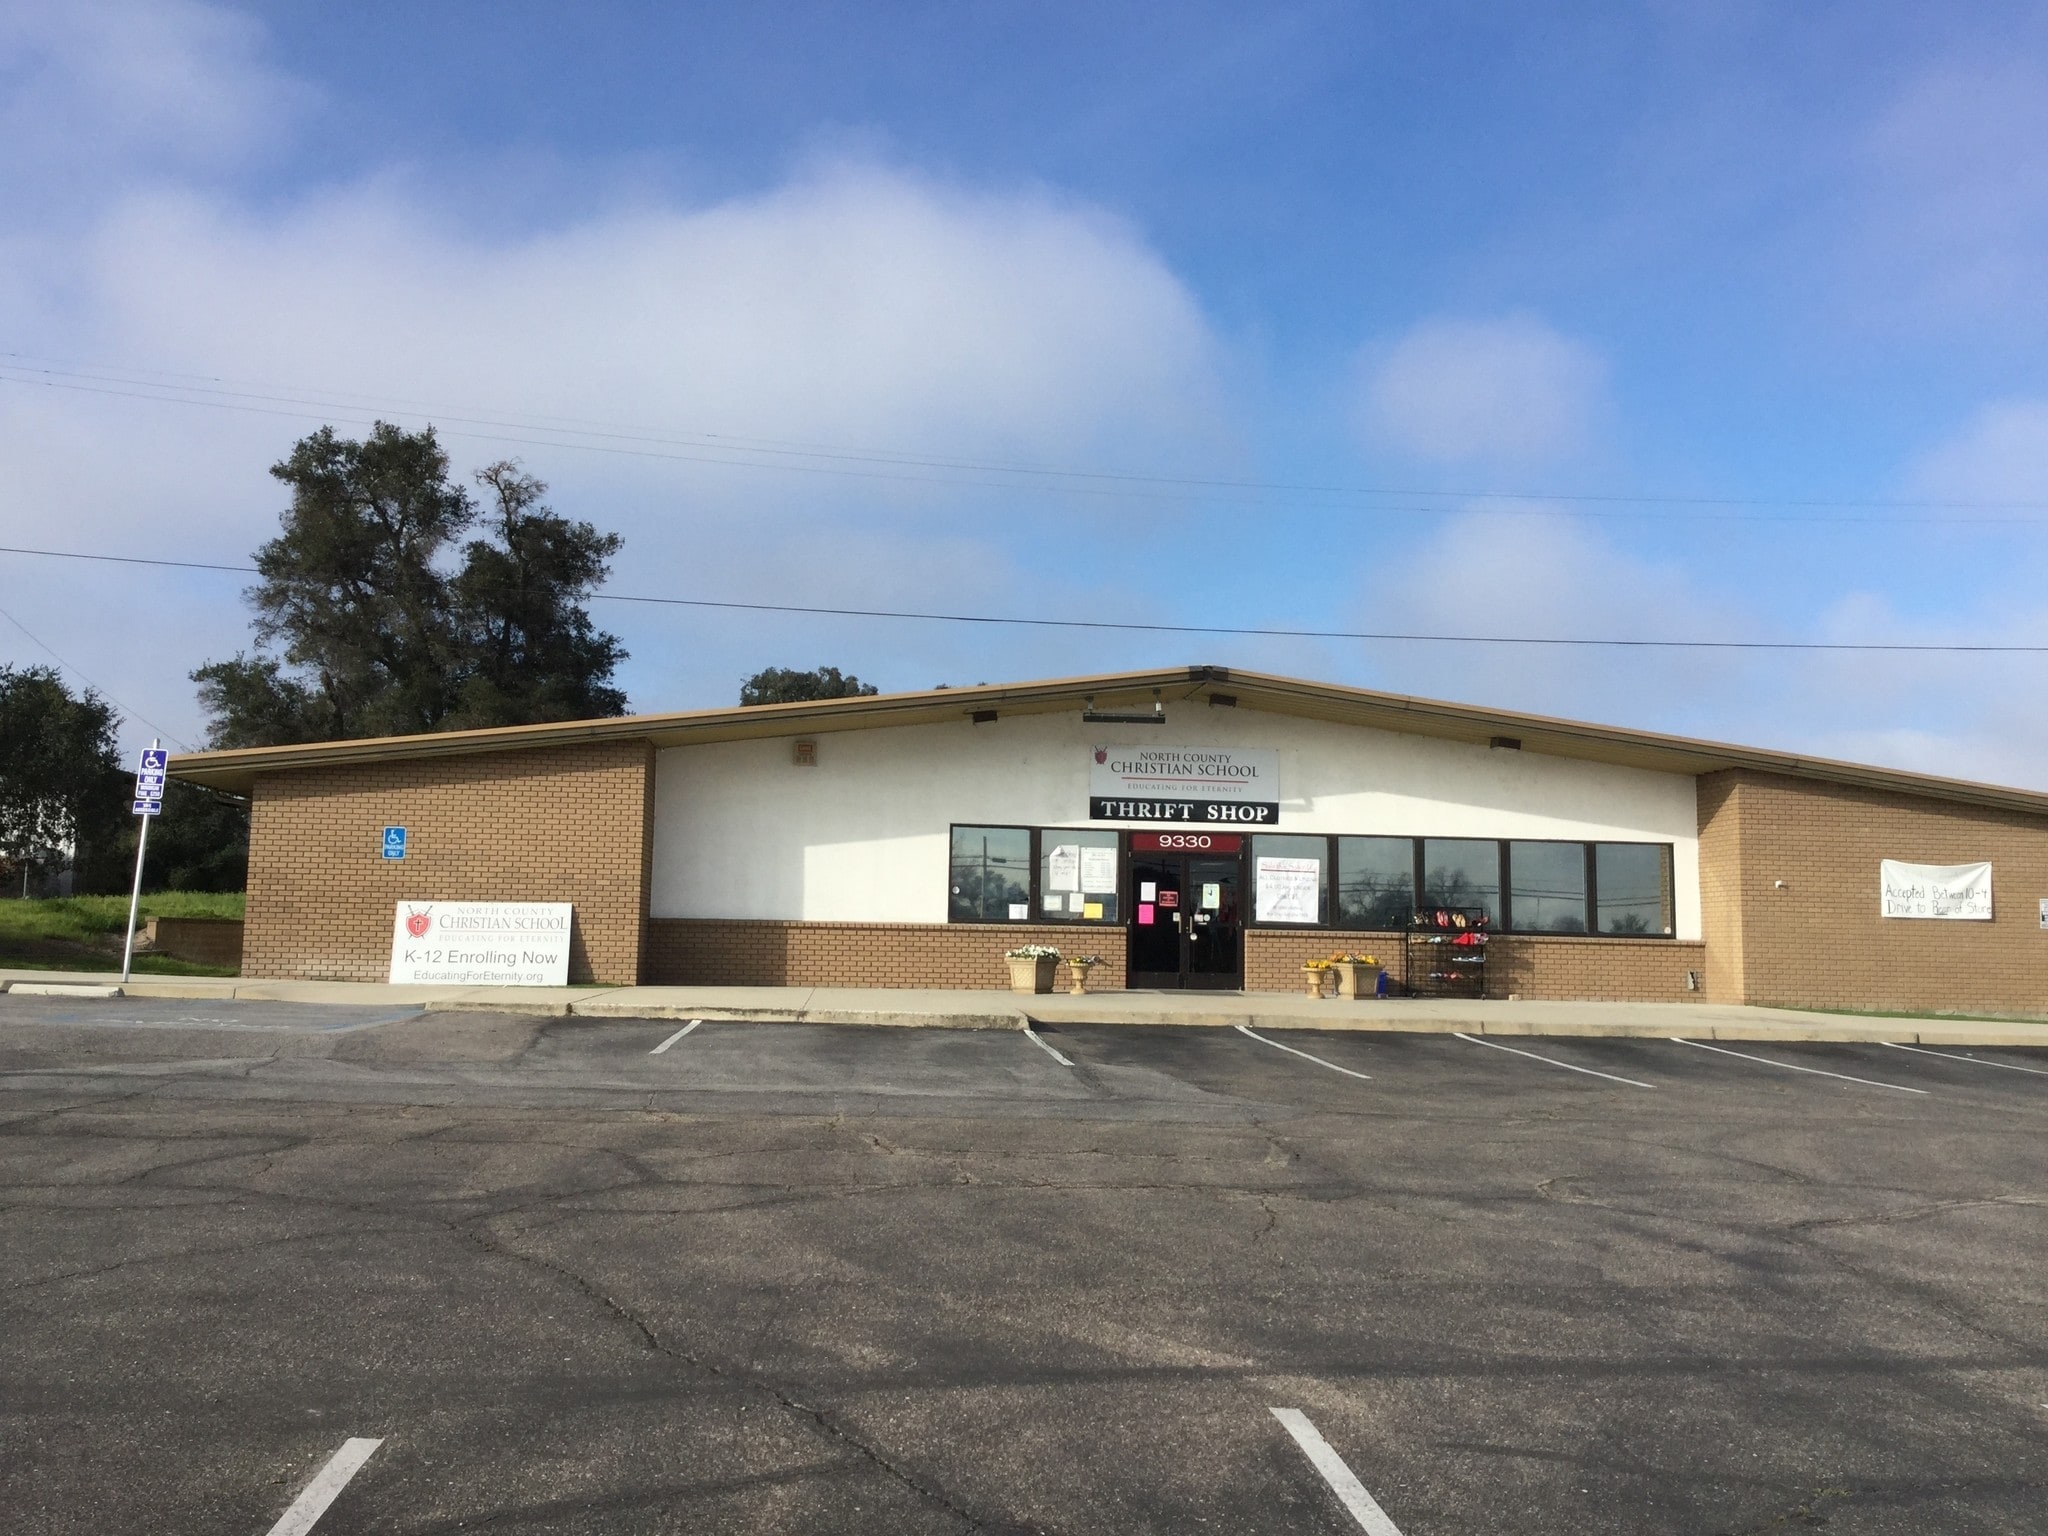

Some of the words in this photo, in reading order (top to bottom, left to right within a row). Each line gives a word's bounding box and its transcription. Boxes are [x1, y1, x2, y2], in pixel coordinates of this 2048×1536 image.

[1140, 751, 1180, 762] NORTH
[1183, 753, 1232, 764] COUNTY
[141, 768, 164, 776] PARKING
[1110, 761, 1193, 775] CHRISTIAN
[1198, 764, 1259, 778] SCHOOL
[144, 776, 158, 784] ONLY
[1127, 783, 1178, 791] EDUCATING
[1202, 785, 1243, 793] ETERNITY
[1101, 800, 1194, 819] THRIFT
[1207, 804, 1269, 822] SHOP
[1159, 834, 1211, 848] 9330
[1885, 884, 1925, 900] Accepted
[1932, 885, 1964, 900] Between
[457, 907, 499, 915] NORTH
[504, 907, 554, 916] COUNTY
[1887, 901, 1912, 914] Drive
[1917, 903, 1926, 914] to
[1966, 903, 1992, 914] Store
[439, 914, 511, 929] CHRISTIAN
[514, 916, 568, 930] SCHOOL
[439, 935, 496, 943] EDUCATING
[500, 935, 516, 943] FOR
[519, 935, 565, 943] ETERNITY
[404, 950, 442, 964] K-12
[447, 950, 517, 967] Enrolling
[522, 951, 558, 964] Now
[413, 970, 544, 983] EducatingForEternity.org
